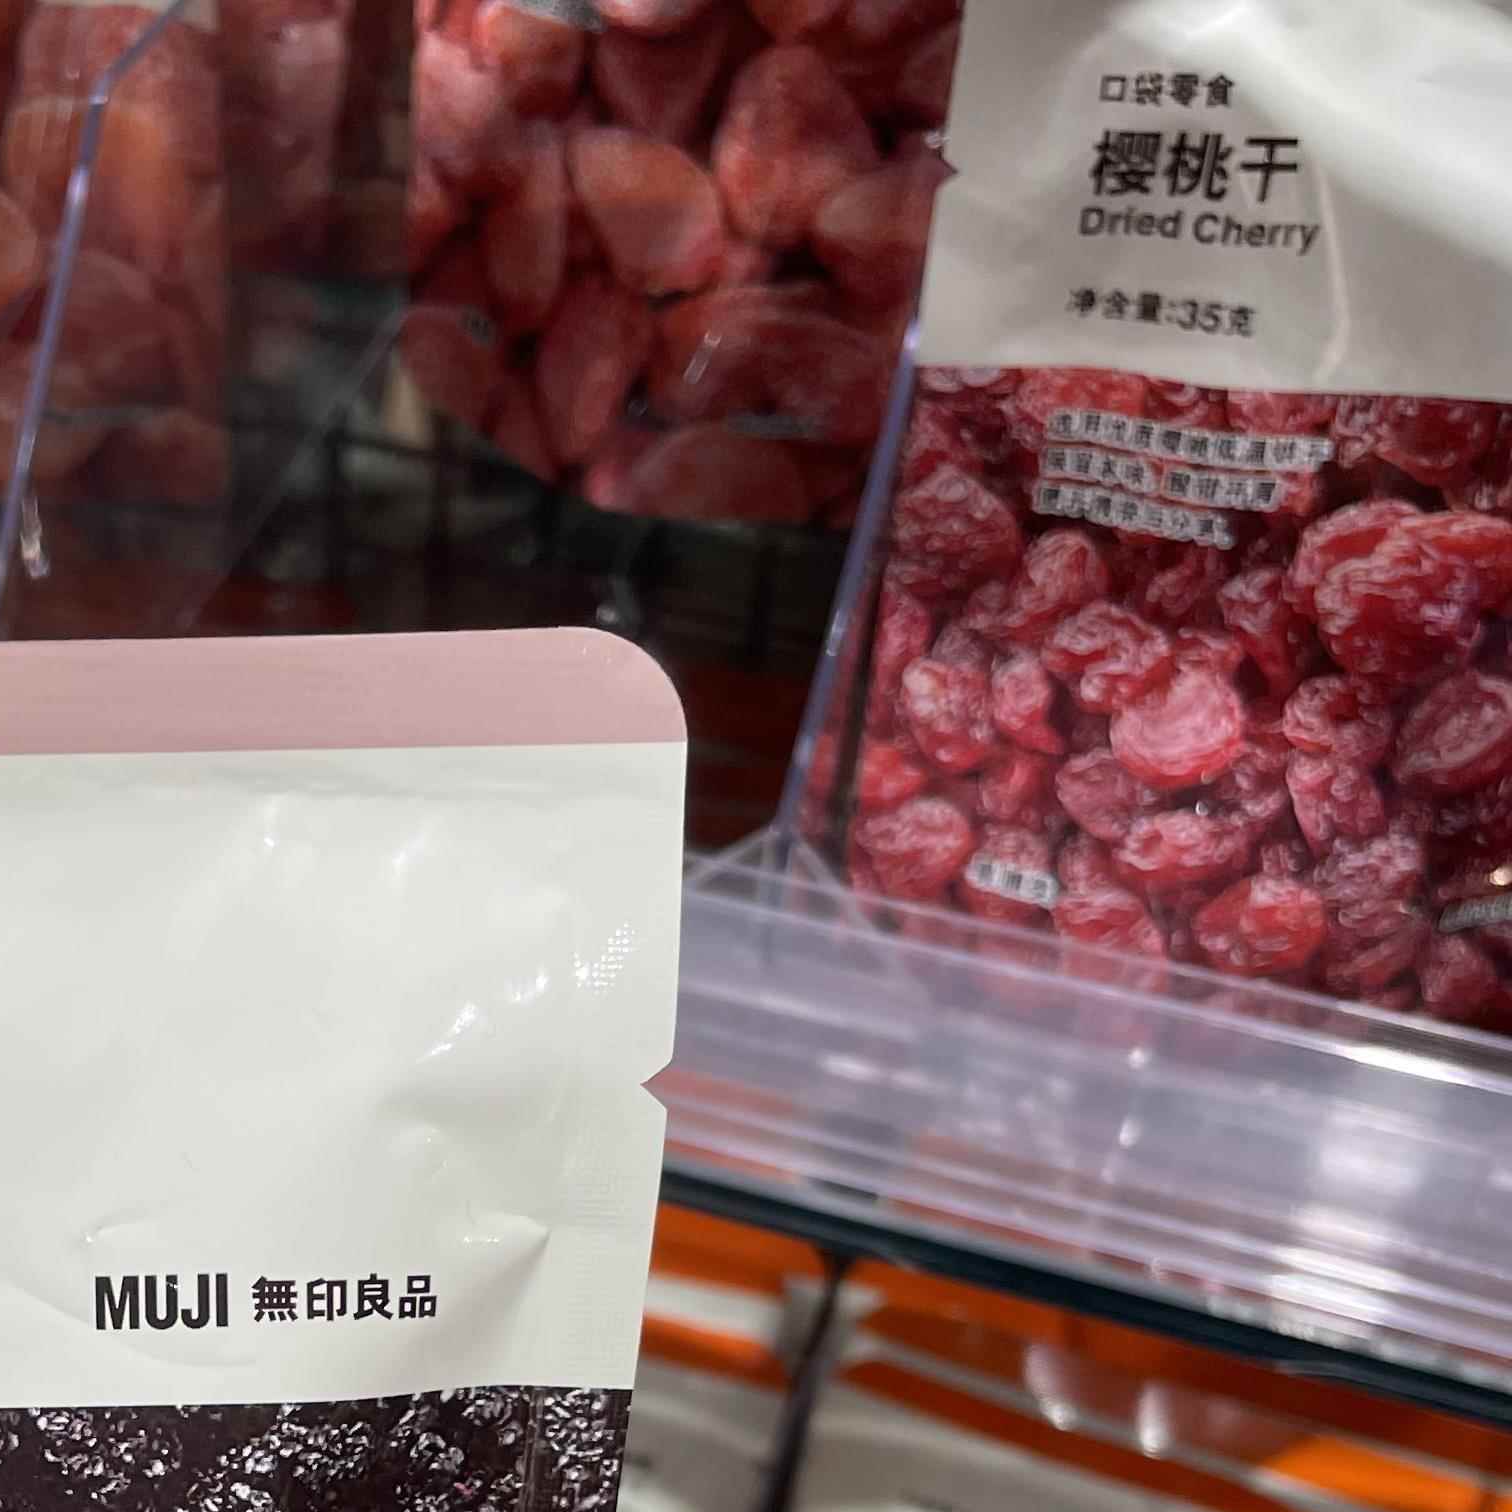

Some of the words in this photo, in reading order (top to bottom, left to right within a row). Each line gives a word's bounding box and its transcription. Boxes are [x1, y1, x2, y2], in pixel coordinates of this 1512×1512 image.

[1099, 73, 1234, 107] 口袋零食
[1091, 130, 1299, 202] 樱桃干
[1079, 206, 1183, 239] Dried
[1193, 212, 1320, 256] Cherry
[95, 1273, 228, 1330] MUJI
[251, 1273, 437, 1322] 無印良品
